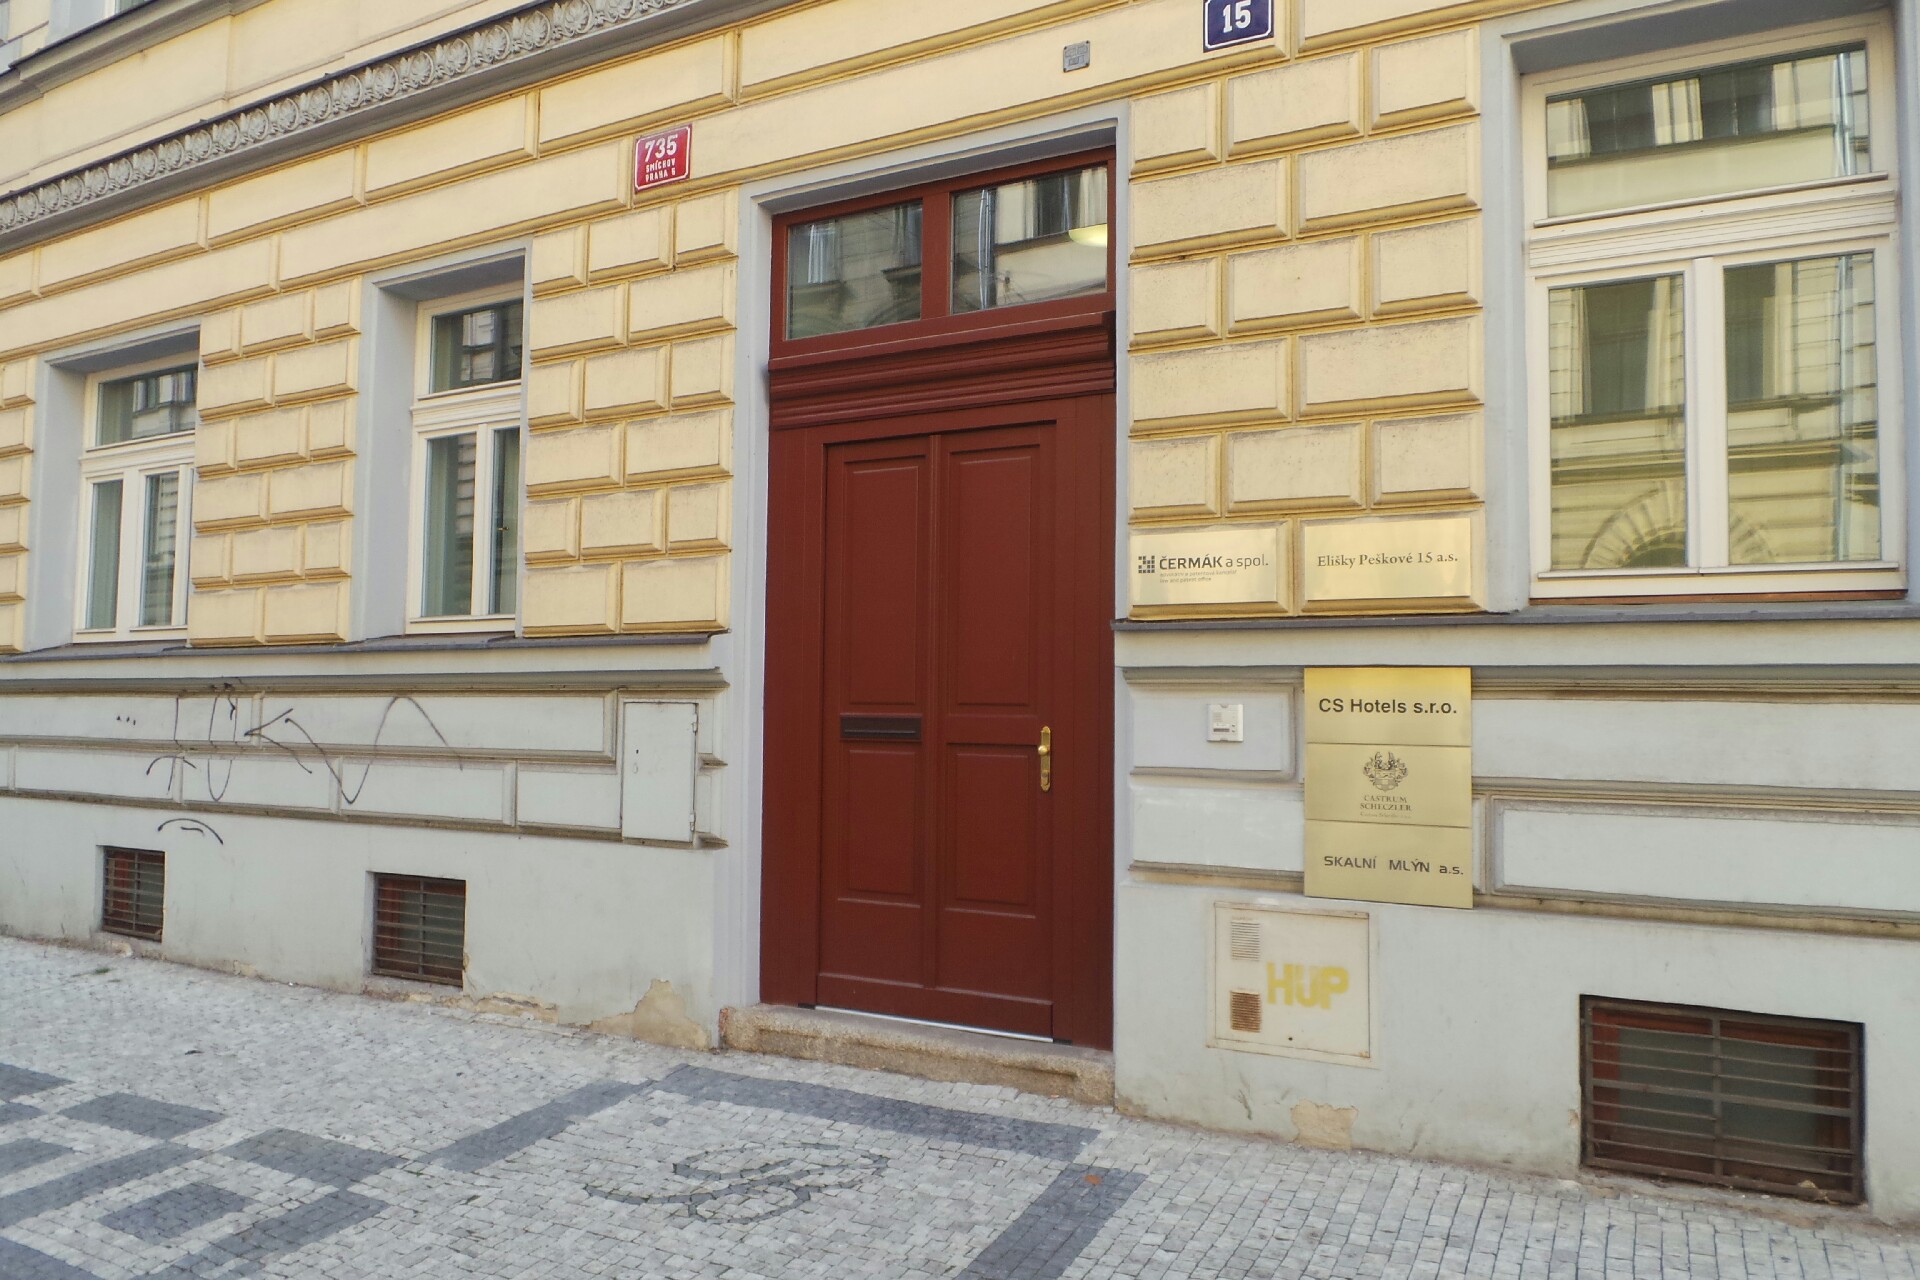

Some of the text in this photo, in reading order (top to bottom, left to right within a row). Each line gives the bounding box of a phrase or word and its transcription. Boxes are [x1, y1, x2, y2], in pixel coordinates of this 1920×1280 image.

[1222, 0, 1251, 33] 15
[645, 134, 678, 162] 735
[645, 158, 676, 173] SMÍCHOV
[645, 169, 668, 183] PRAHA
[1159, 554, 1269, 570] ČERMÁK a spol.
[1317, 551, 1458, 569] Elišky Peškové 15 a.s.
[1319, 698, 1457, 714] CS Hotels s.r.o.
[1364, 795, 1407, 803] CASTRUM
[1324, 855, 1464, 875] SKALNÍ MLÝN a.s.
[1266, 962, 1349, 1010] HUP
